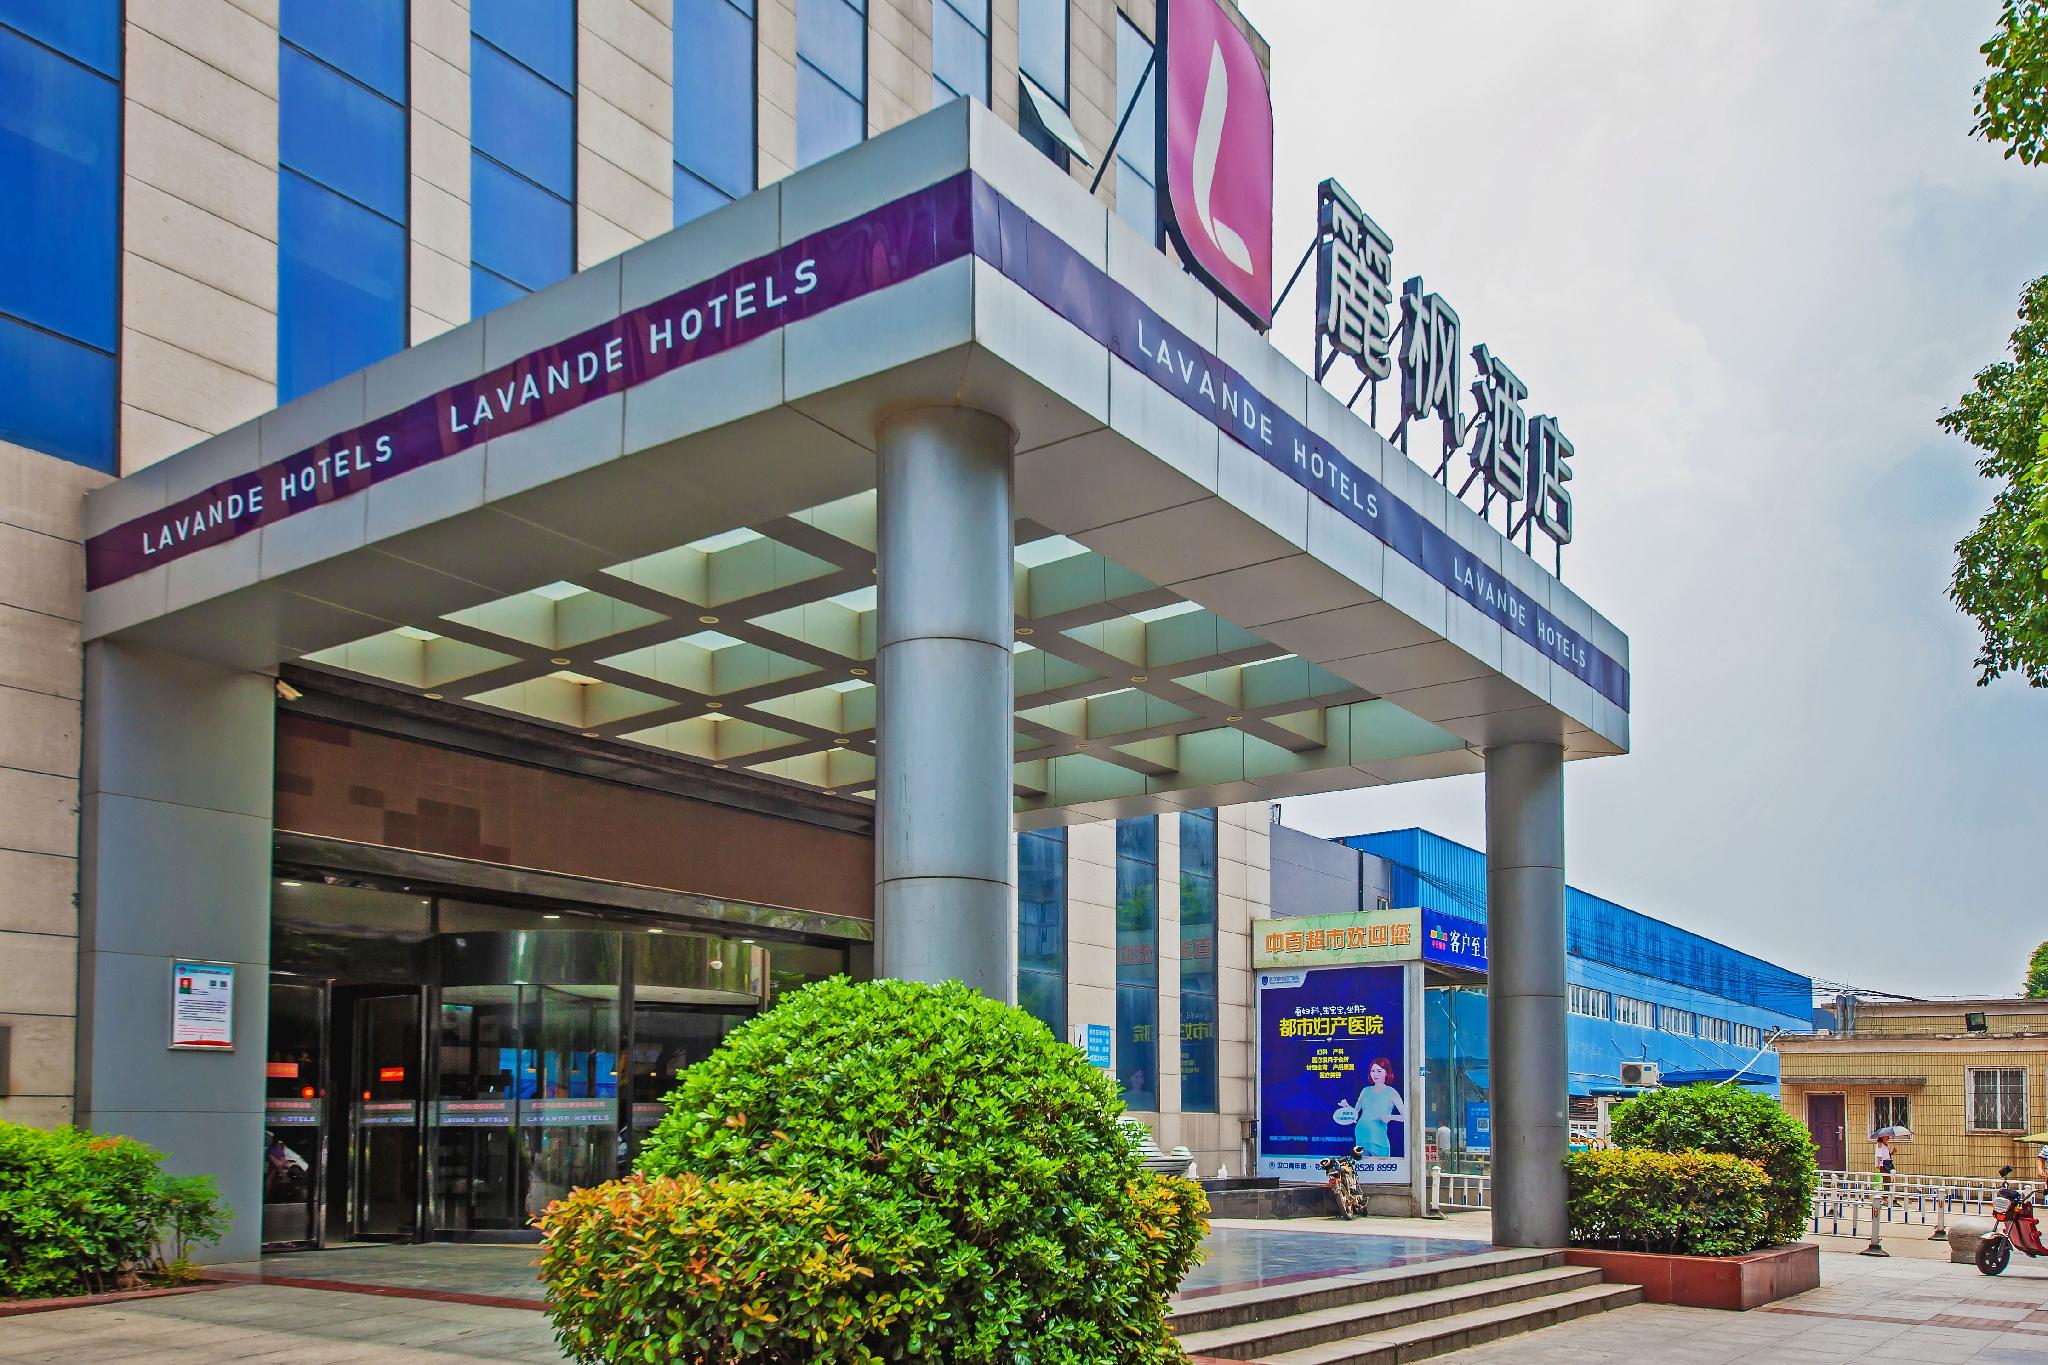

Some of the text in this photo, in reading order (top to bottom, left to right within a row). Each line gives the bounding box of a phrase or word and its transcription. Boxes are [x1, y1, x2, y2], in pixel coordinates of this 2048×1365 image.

[449, 258, 818, 433] LAVANDE HOTELS
[1137, 318, 1379, 519] LAVANDE HOTELS
[143, 434, 394, 555] LAVANDE HOTELS
[1454, 557, 1586, 669] LAVANDE HOTELS
[1265, 923, 1411, 954] 中百超市欢迎您
[1279, 1014, 1384, 1038] 都市妇产医院
[1354, 1163, 1375, 1172] 8526
[1377, 1163, 1398, 1172] 8999
